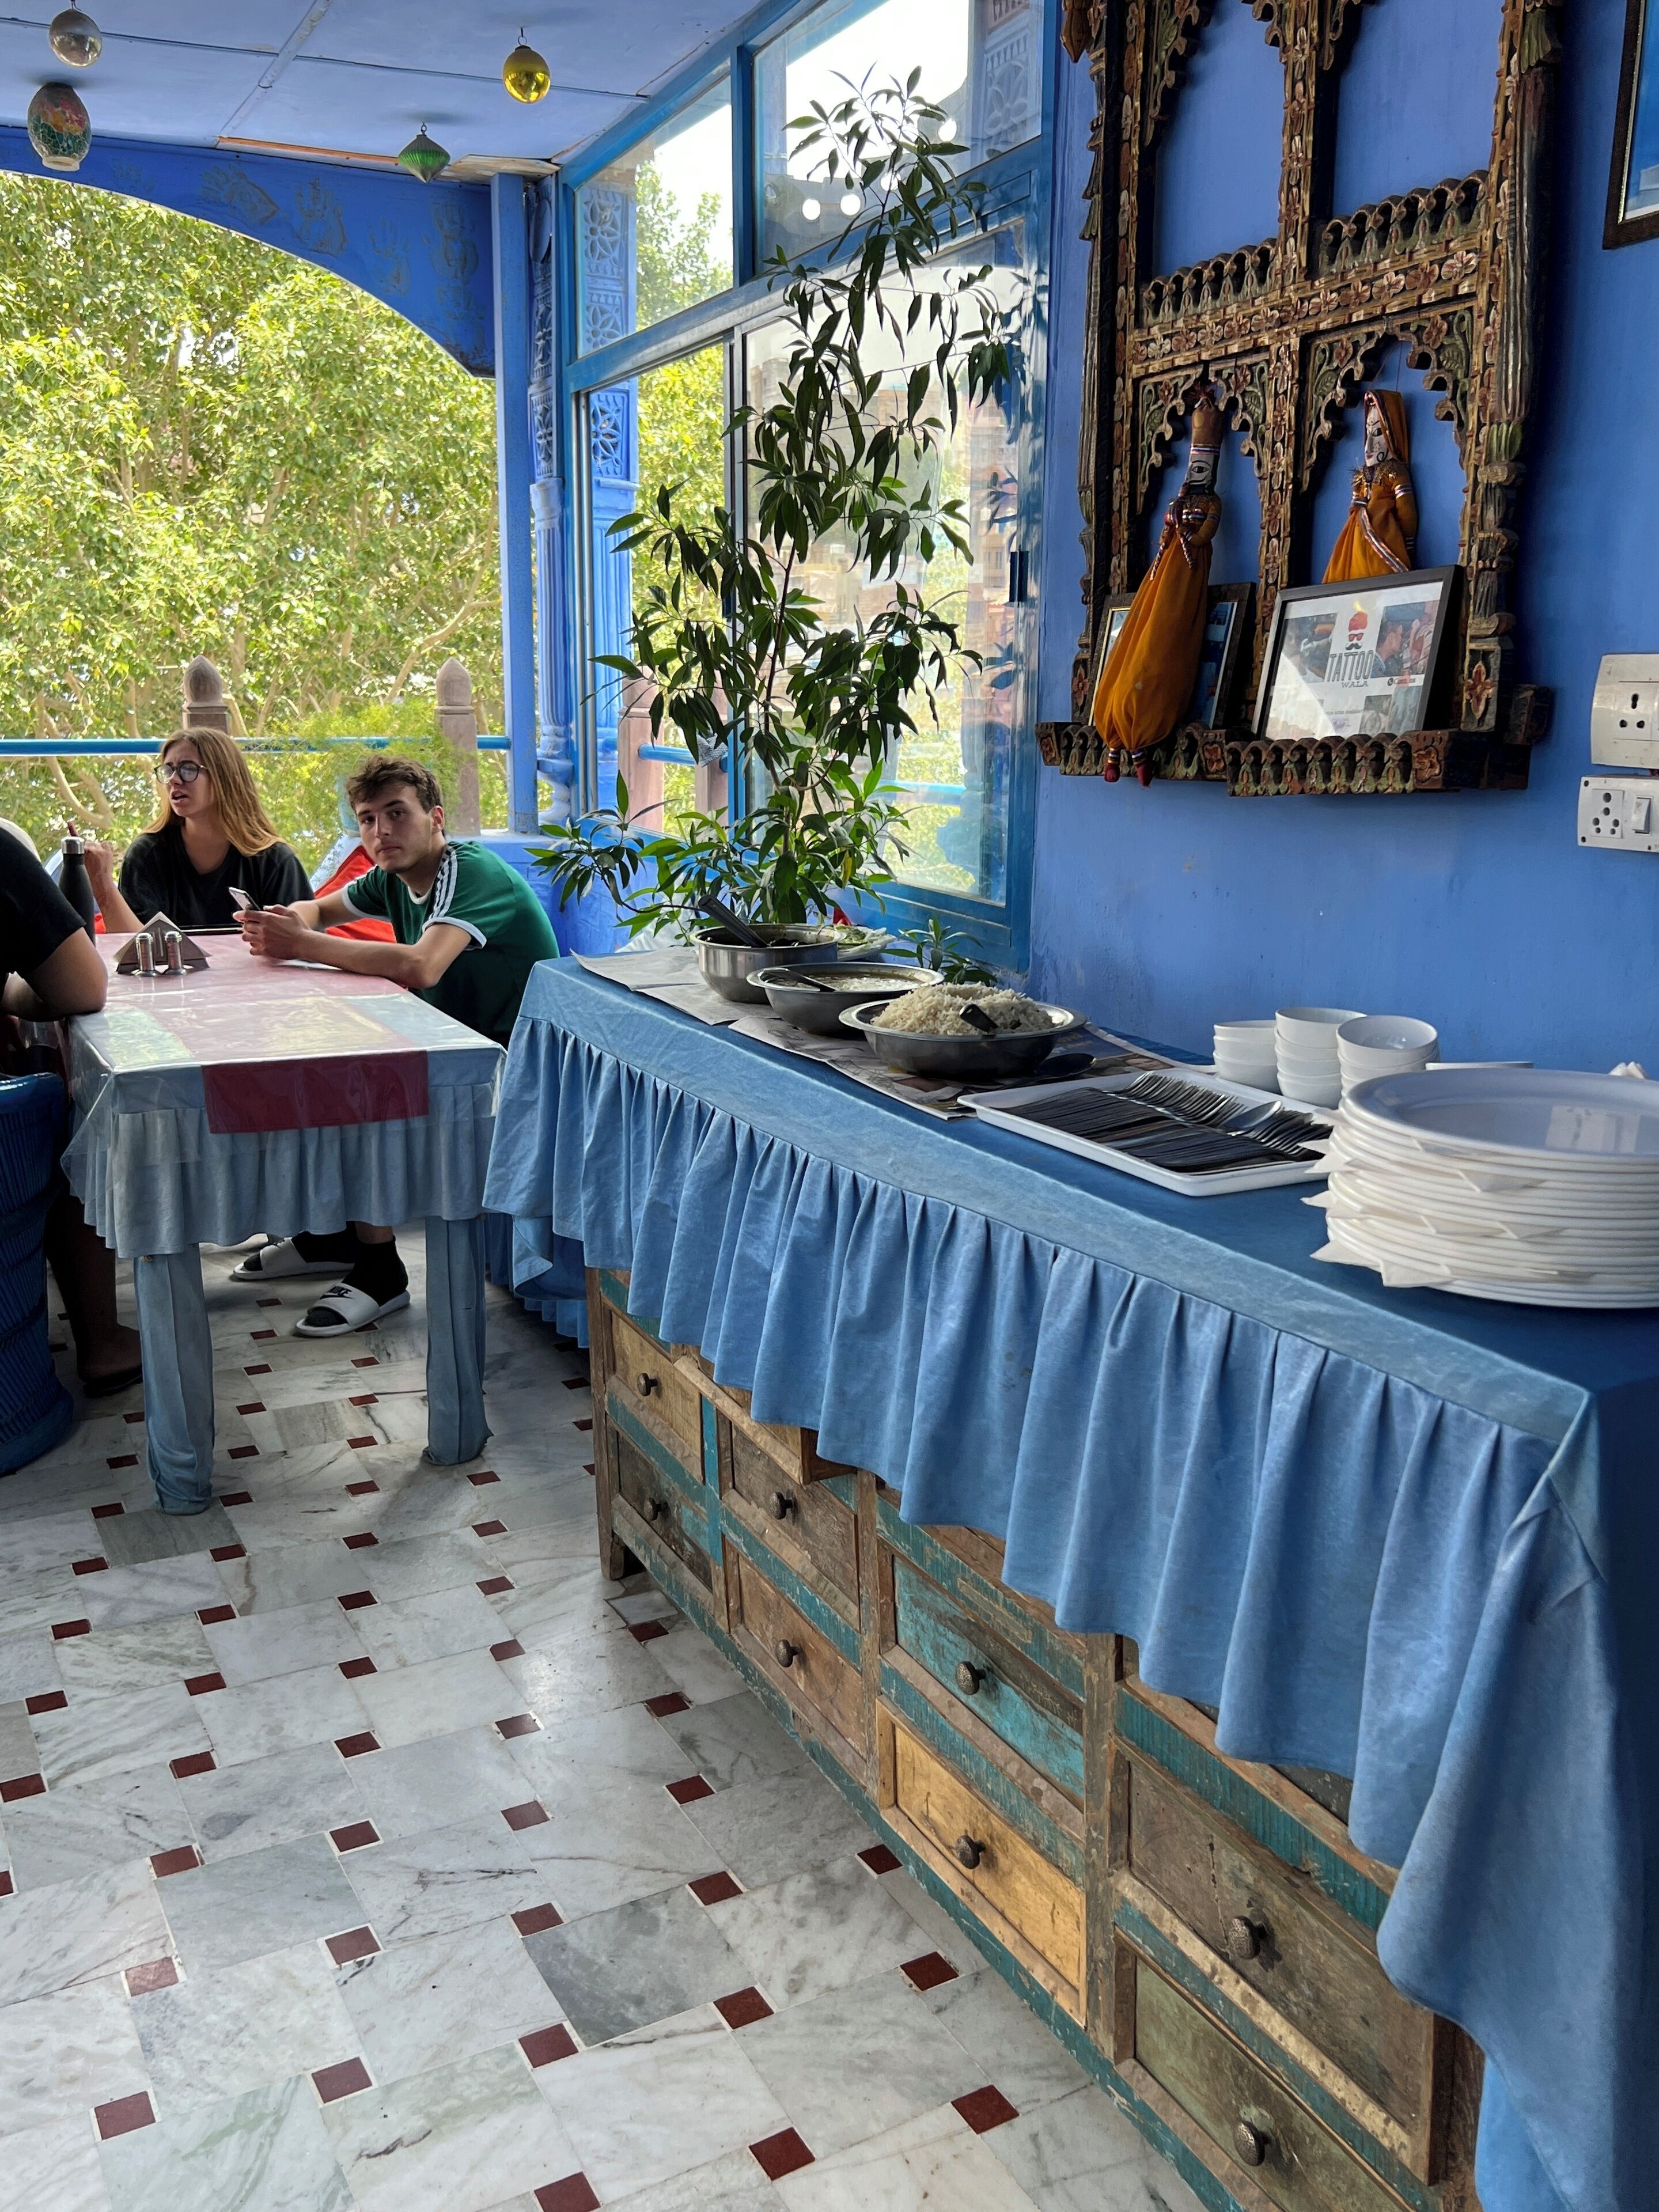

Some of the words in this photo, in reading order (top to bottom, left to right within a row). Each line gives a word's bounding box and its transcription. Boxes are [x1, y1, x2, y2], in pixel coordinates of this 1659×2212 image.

[1327, 650, 1374, 682] TATTOO
[1341, 680, 1369, 688] WALA
[327, 1286, 352, 1296] NIKE
